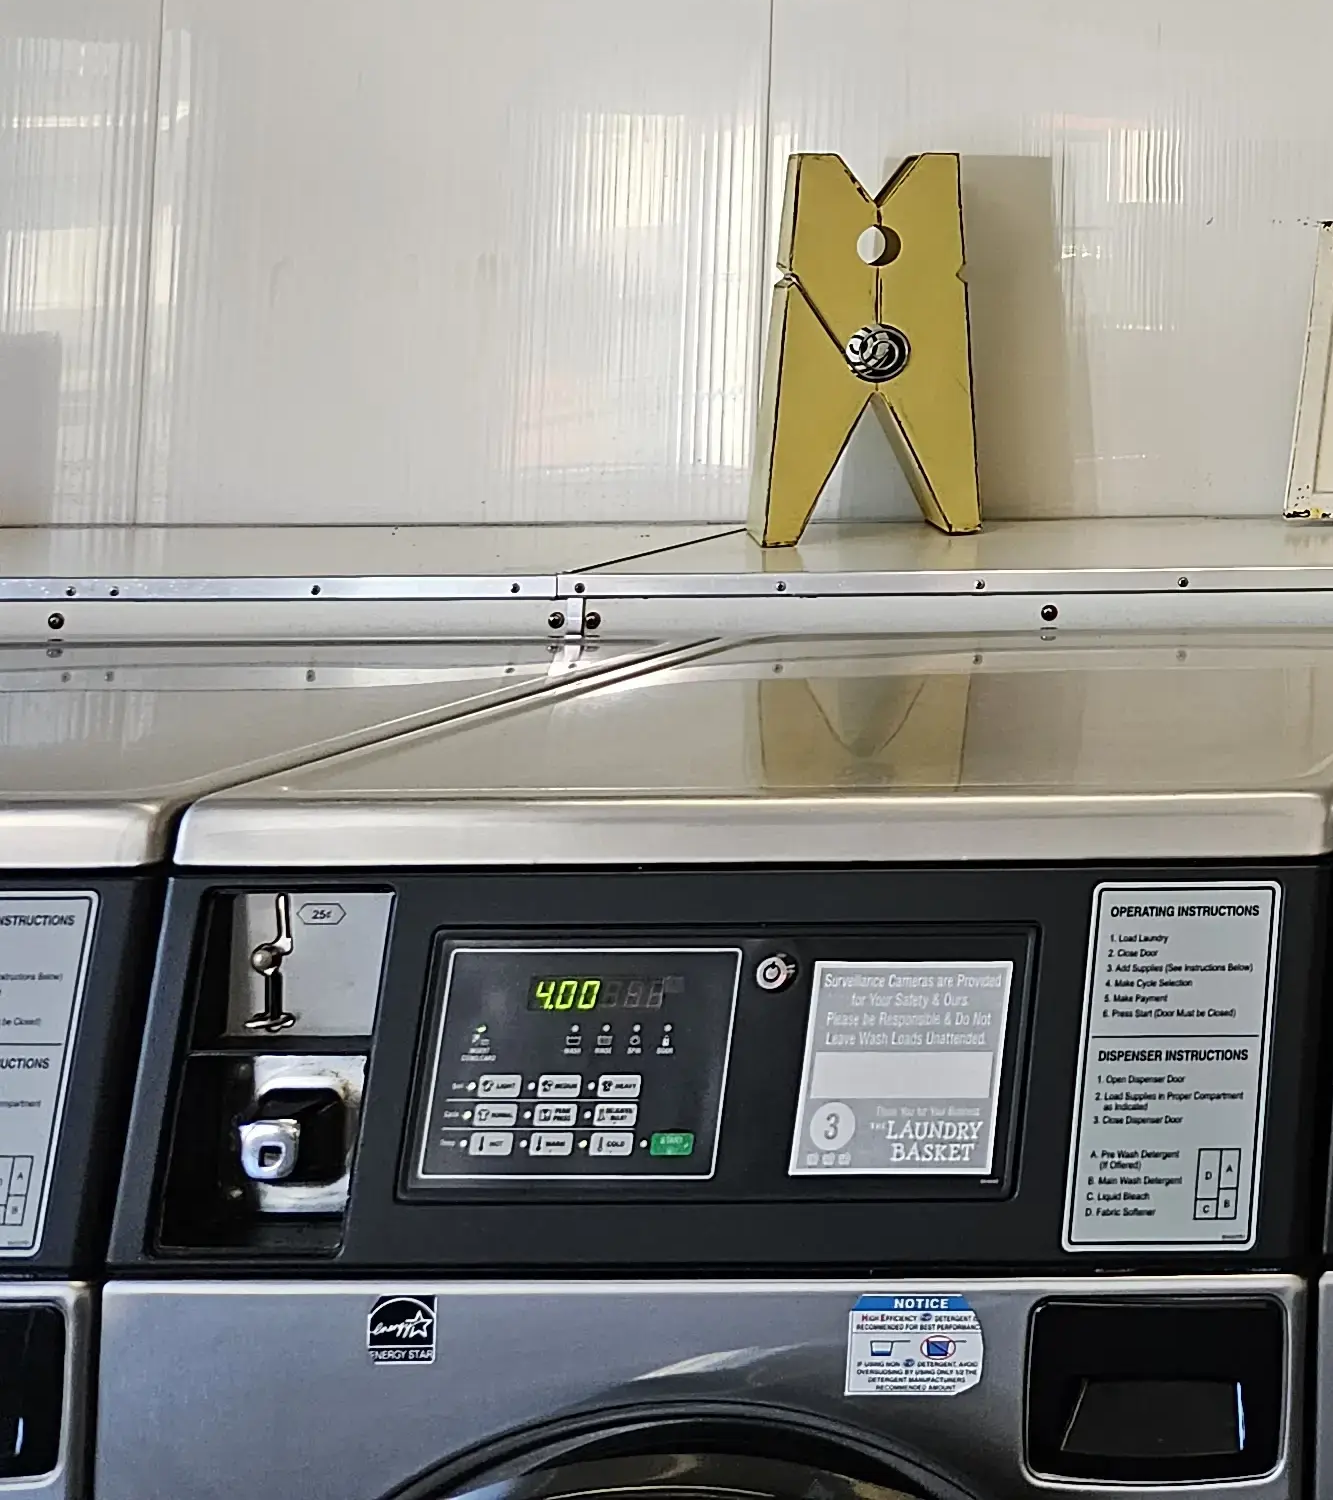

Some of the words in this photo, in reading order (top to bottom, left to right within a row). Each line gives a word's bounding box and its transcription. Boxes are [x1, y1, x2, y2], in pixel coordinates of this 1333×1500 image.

[1111, 906, 1175, 917] OPERATING
[1177, 905, 1260, 917] INSTRUCTIONS
[535, 980, 600, 1010] 4.00
[1098, 1050, 1162, 1061] DISPENSER
[1165, 1050, 1248, 1061] INSTRUCTIONS
[824, 1113, 840, 1139] 3
[885, 1120, 983, 1139] LAUNDRY
[890, 1143, 975, 1162] BASKET
[894, 1299, 949, 1309] NOTICE
[409, 1350, 433, 1359] STAR
